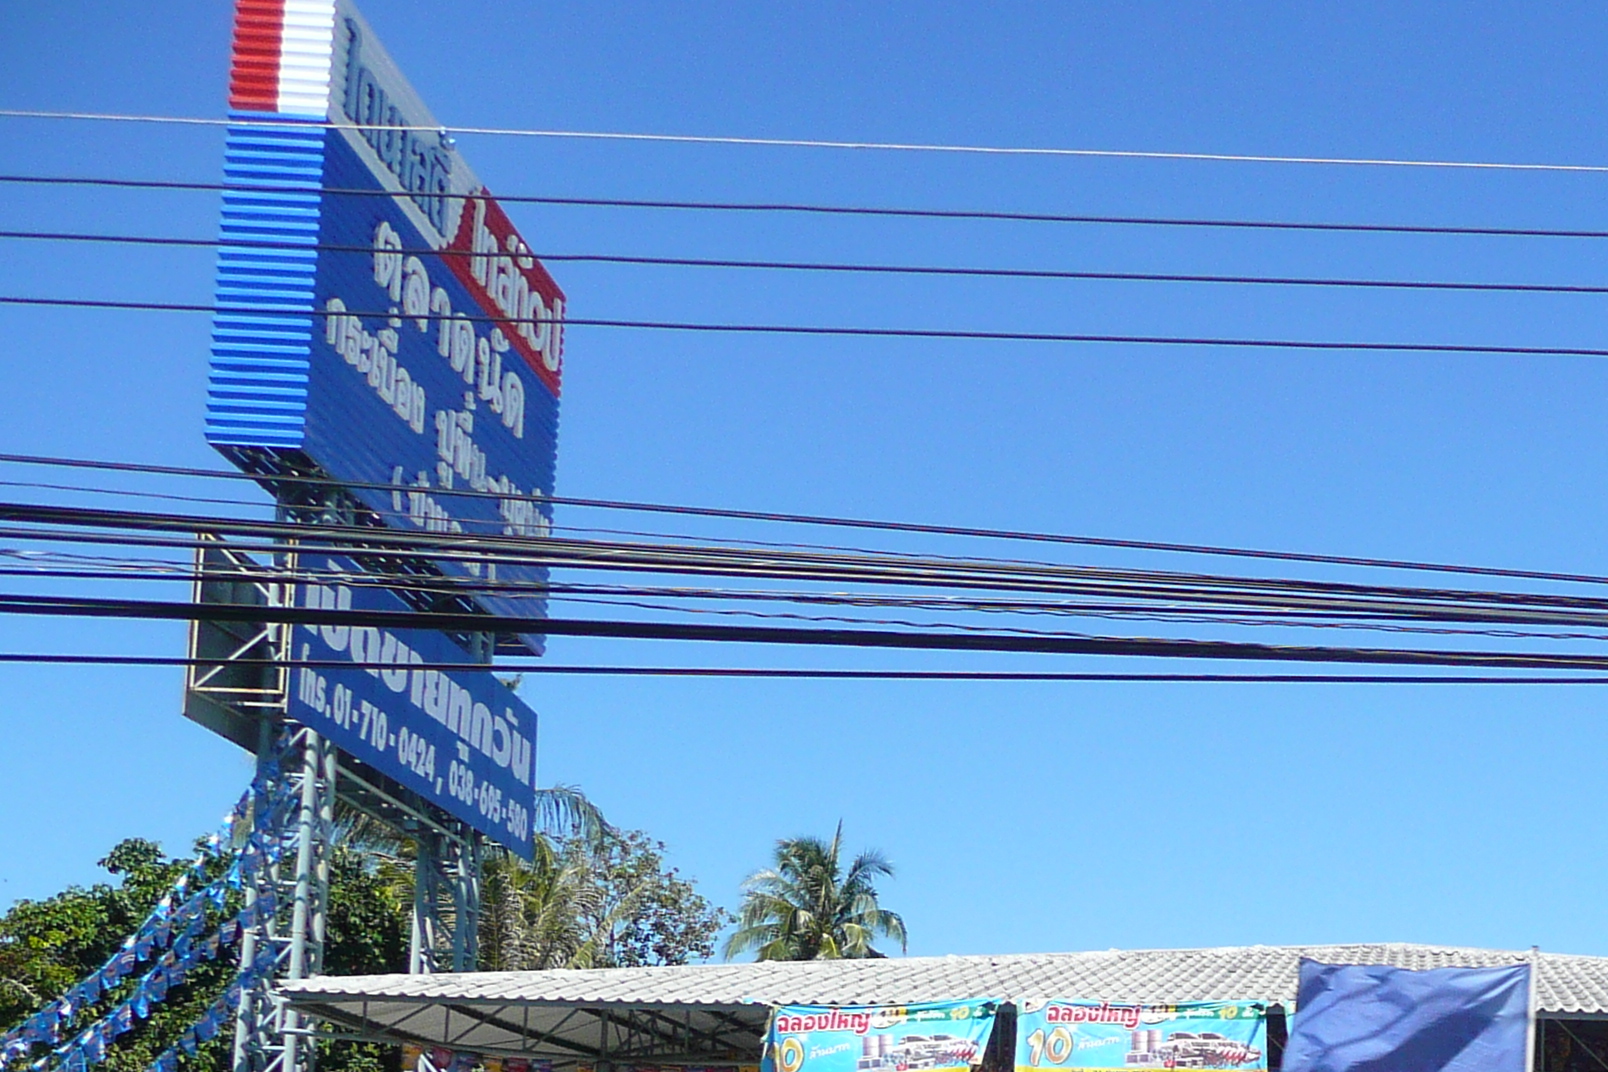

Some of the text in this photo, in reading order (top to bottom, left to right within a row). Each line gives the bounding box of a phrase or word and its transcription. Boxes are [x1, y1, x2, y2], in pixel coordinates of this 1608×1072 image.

[373, 221, 525, 438] ตลาดนัด
[776, 1009, 872, 1034] ฉลองใหญ่
[1046, 1002, 1141, 1028] ฉลองใหญ่
[1026, 1026, 1073, 1066] 10
